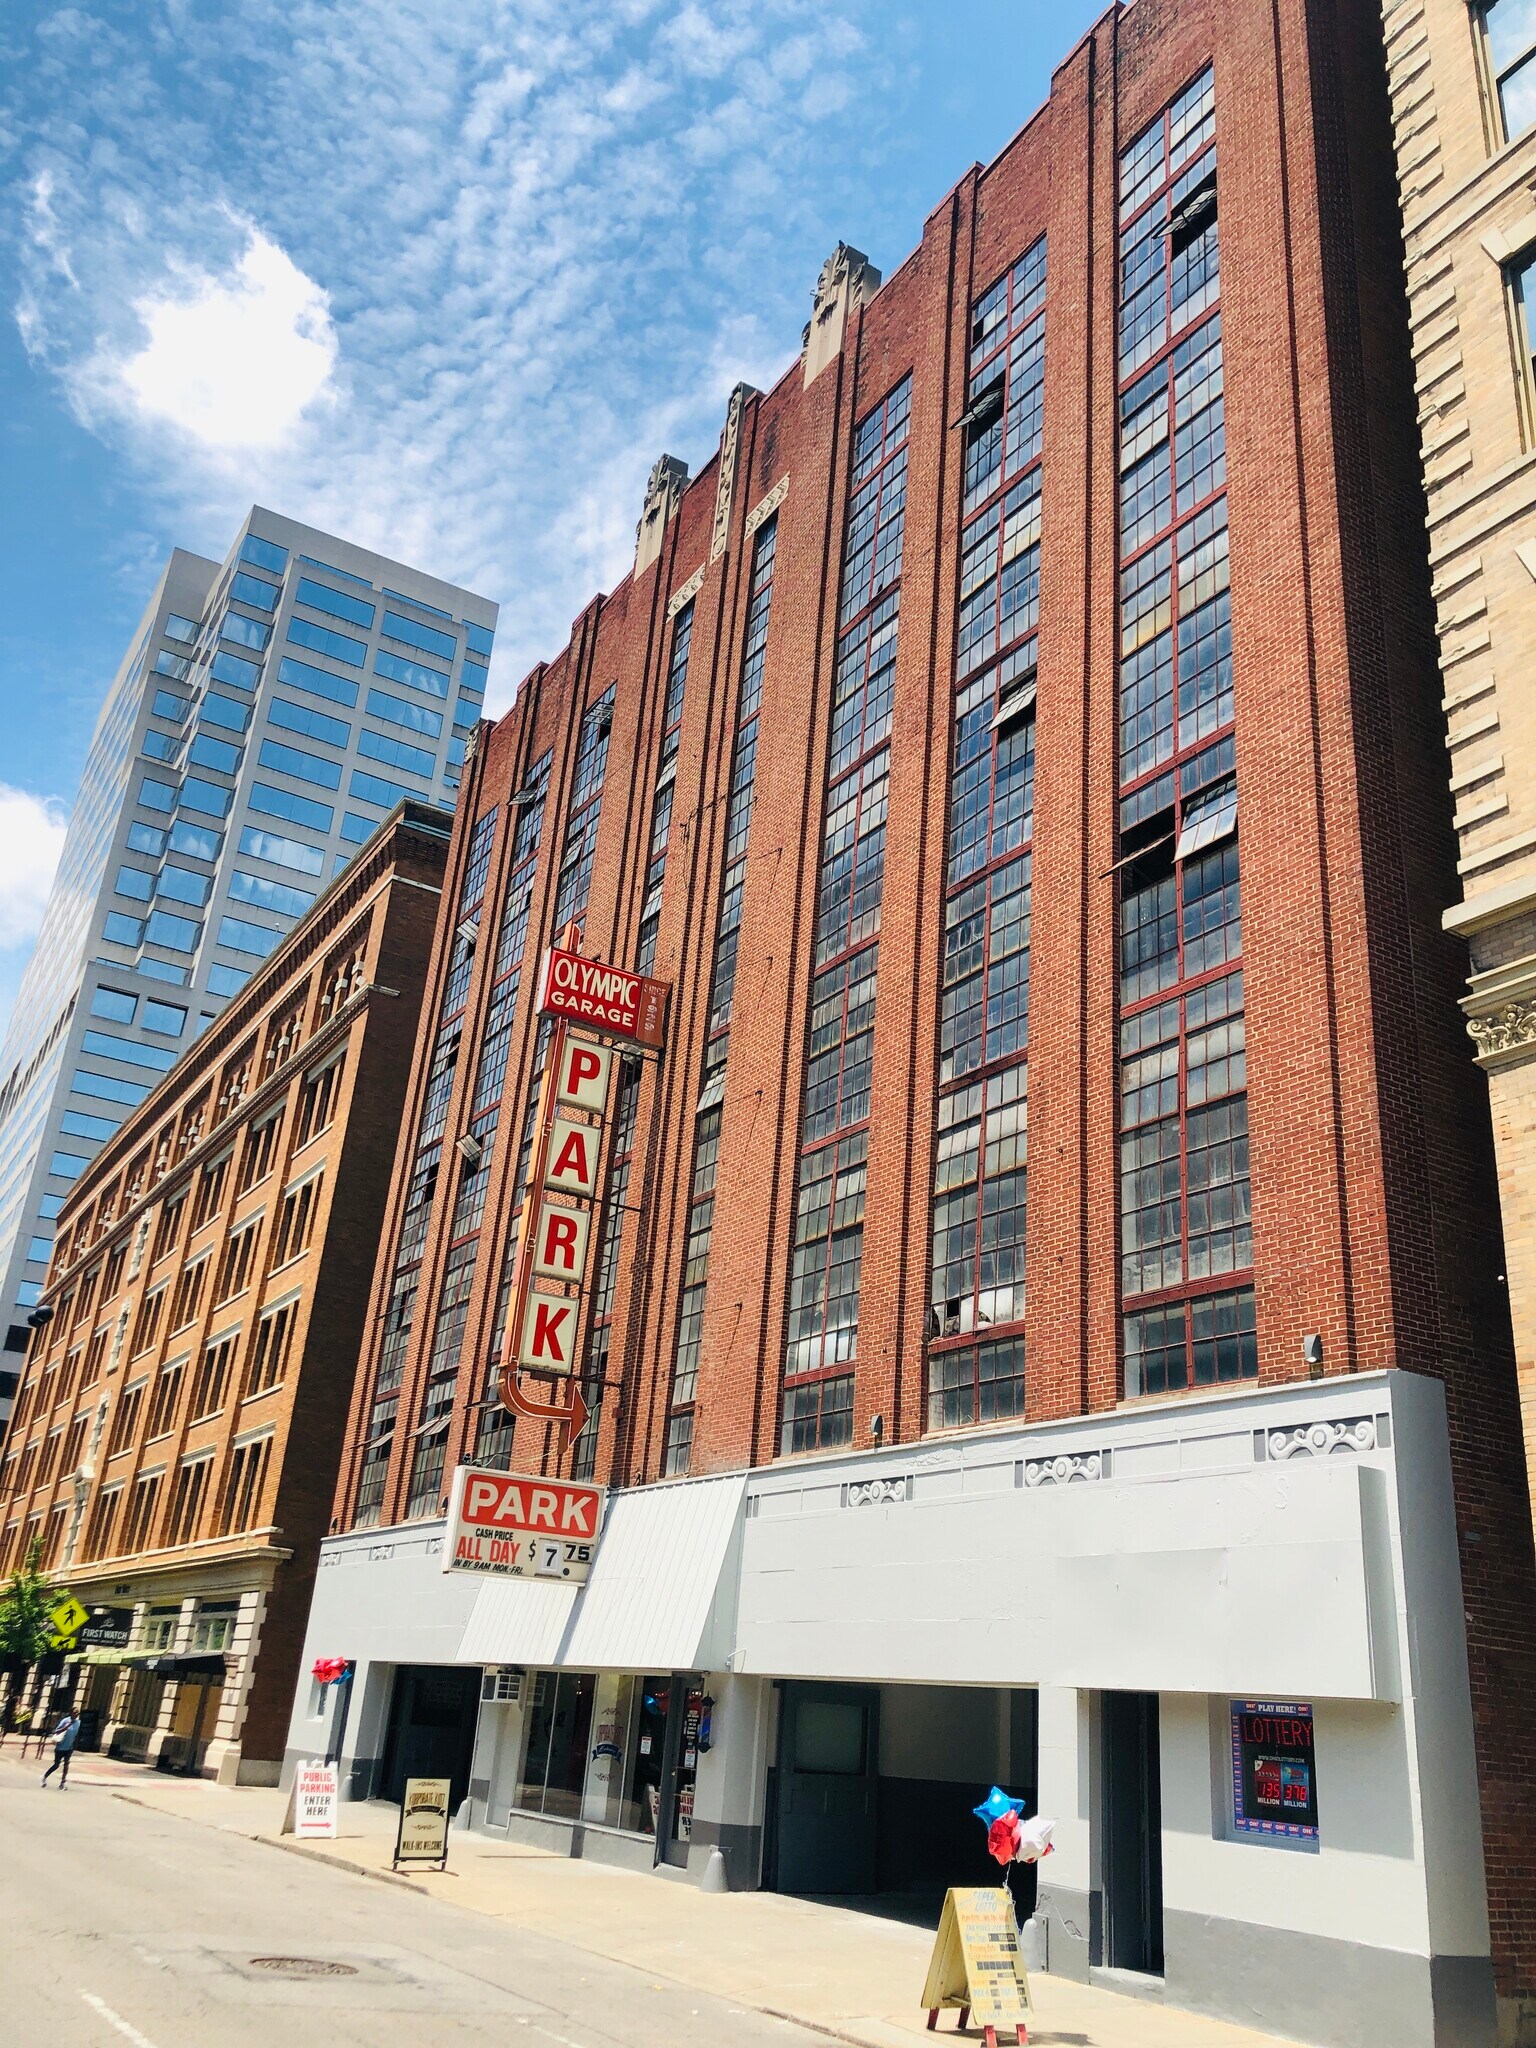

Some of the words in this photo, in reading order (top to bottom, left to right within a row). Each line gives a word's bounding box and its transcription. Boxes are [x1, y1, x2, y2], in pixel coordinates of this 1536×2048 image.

[554, 958, 639, 1009] OLYMPIC
[550, 991, 635, 1028] GARAGE
[531, 1047, 601, 1362] PARK
[467, 1481, 593, 1532] PARK
[475, 1528, 493, 1539] CASH
[494, 1530, 514, 1542] PRICE
[455, 1536, 483, 1560] ALL
[489, 1540, 521, 1565] DAY
[453, 1558, 461, 1567] IN
[462, 1560, 472, 1568] BY
[474, 1561, 491, 1571] 9AM
[82, 1628, 104, 1638] FIRST
[104, 1630, 128, 1640] WATCH
[1258, 1704, 1275, 1713] PLAY
[1275, 1705, 1297, 1714] HERE!
[1245, 1718, 1313, 1747] LOTTERY
[304, 1772, 333, 1782] PUBLIC
[300, 1783, 335, 1793] PARKING
[1261, 1783, 1280, 1798] 135
[304, 1796, 331, 1805] ENTER
[1257, 1797, 1280, 1805] MILLION
[1283, 1800, 1307, 1809] MILLION
[306, 1806, 328, 1816] HERE
[423, 1840, 442, 1850] WELCOME
[973, 1890, 996, 1901] SUPER
[975, 1901, 997, 1912] LOTTO
